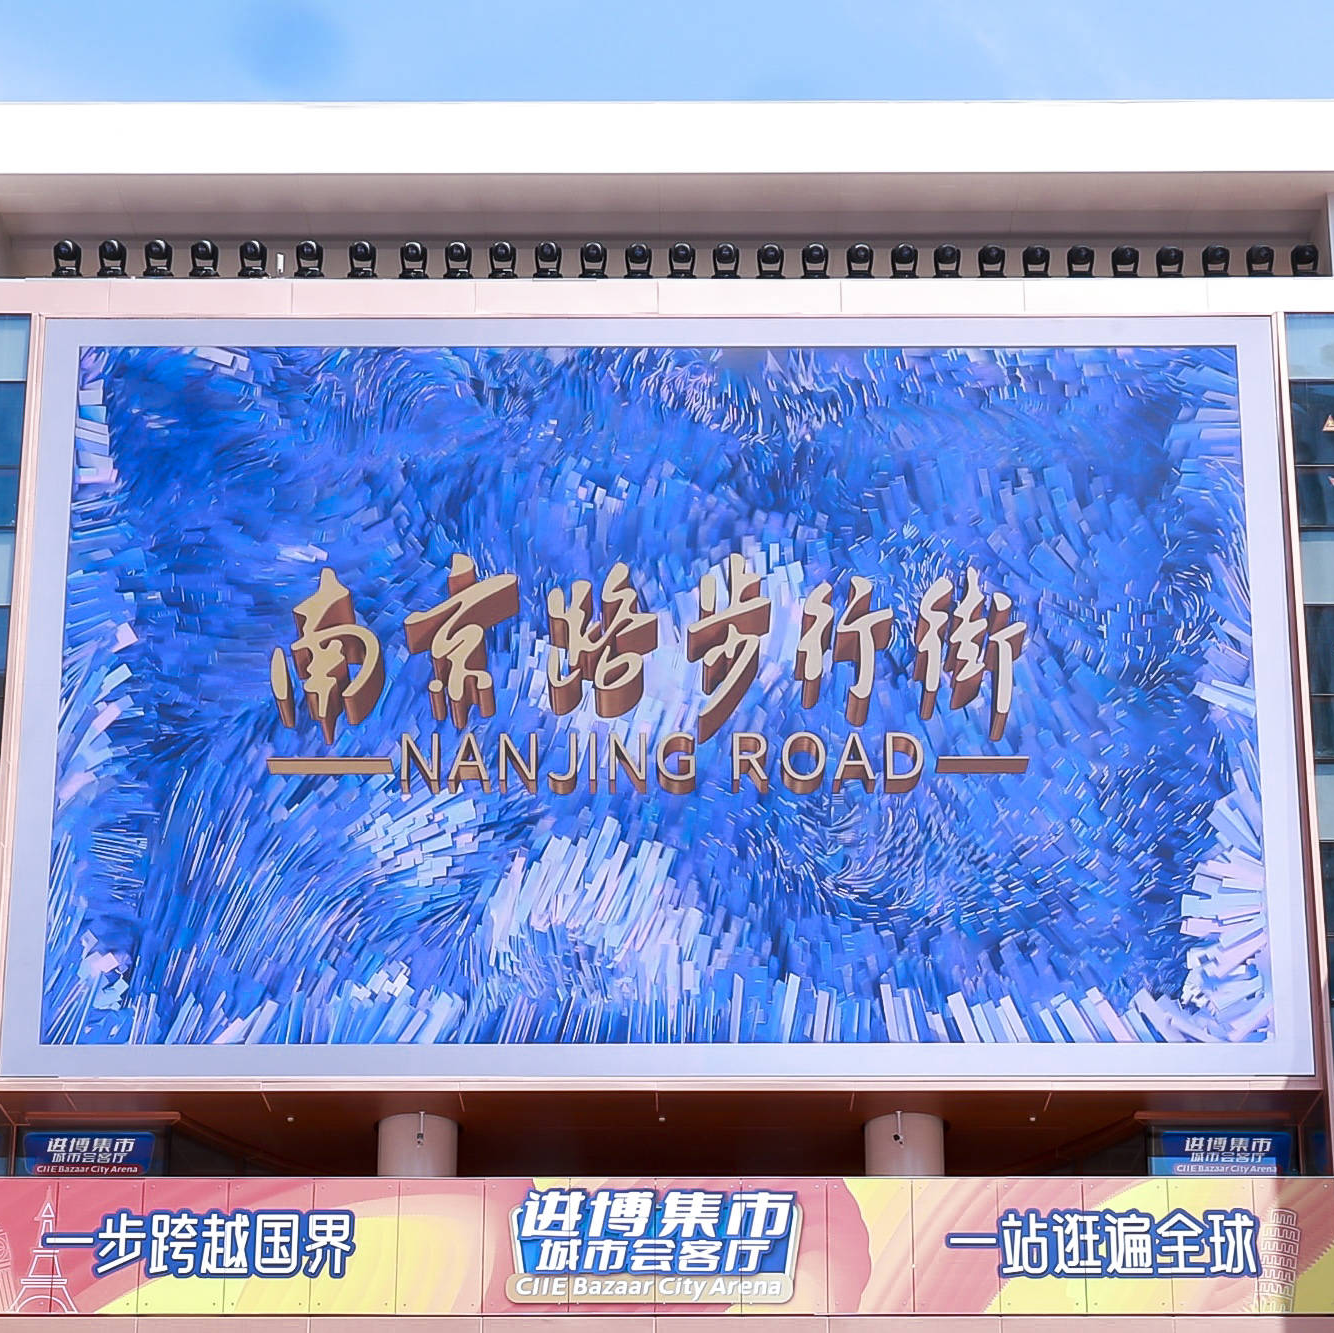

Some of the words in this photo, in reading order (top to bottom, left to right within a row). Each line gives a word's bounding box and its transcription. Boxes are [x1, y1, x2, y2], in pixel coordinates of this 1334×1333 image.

[269, 552, 1027, 744] 南京路步行街
[397, 731, 697, 794] NANJING
[730, 731, 927, 794] ROAD
[47, 1137, 137, 1153] 进博集市
[1185, 1136, 1272, 1152] 进博集市
[51, 1153, 128, 1163] 城市会客厅
[1190, 1152, 1265, 1162] 城市会客厅
[1198, 1164, 1229, 1173] Bazaar
[1230, 1164, 1248, 1174] City
[1250, 1164, 1278, 1173] Arena
[36, 1165, 57, 1173] CIIE
[58, 1165, 88, 1173] Bazaar
[90, 1165, 109, 1175] City
[111, 1165, 138, 1173] Arena
[521, 1191, 794, 1238] 进博集市
[46, 1212, 355, 1276] 一步跨越国界
[535, 1239, 771, 1272] 城市会客厅
[949, 1211, 1257, 1276] 一站逛遍全球
[516, 1276, 567, 1297] CIIE
[573, 1276, 654, 1297] Bazaar
[658, 1276, 709, 1300] City
[709, 1276, 782, 1297] Arena
